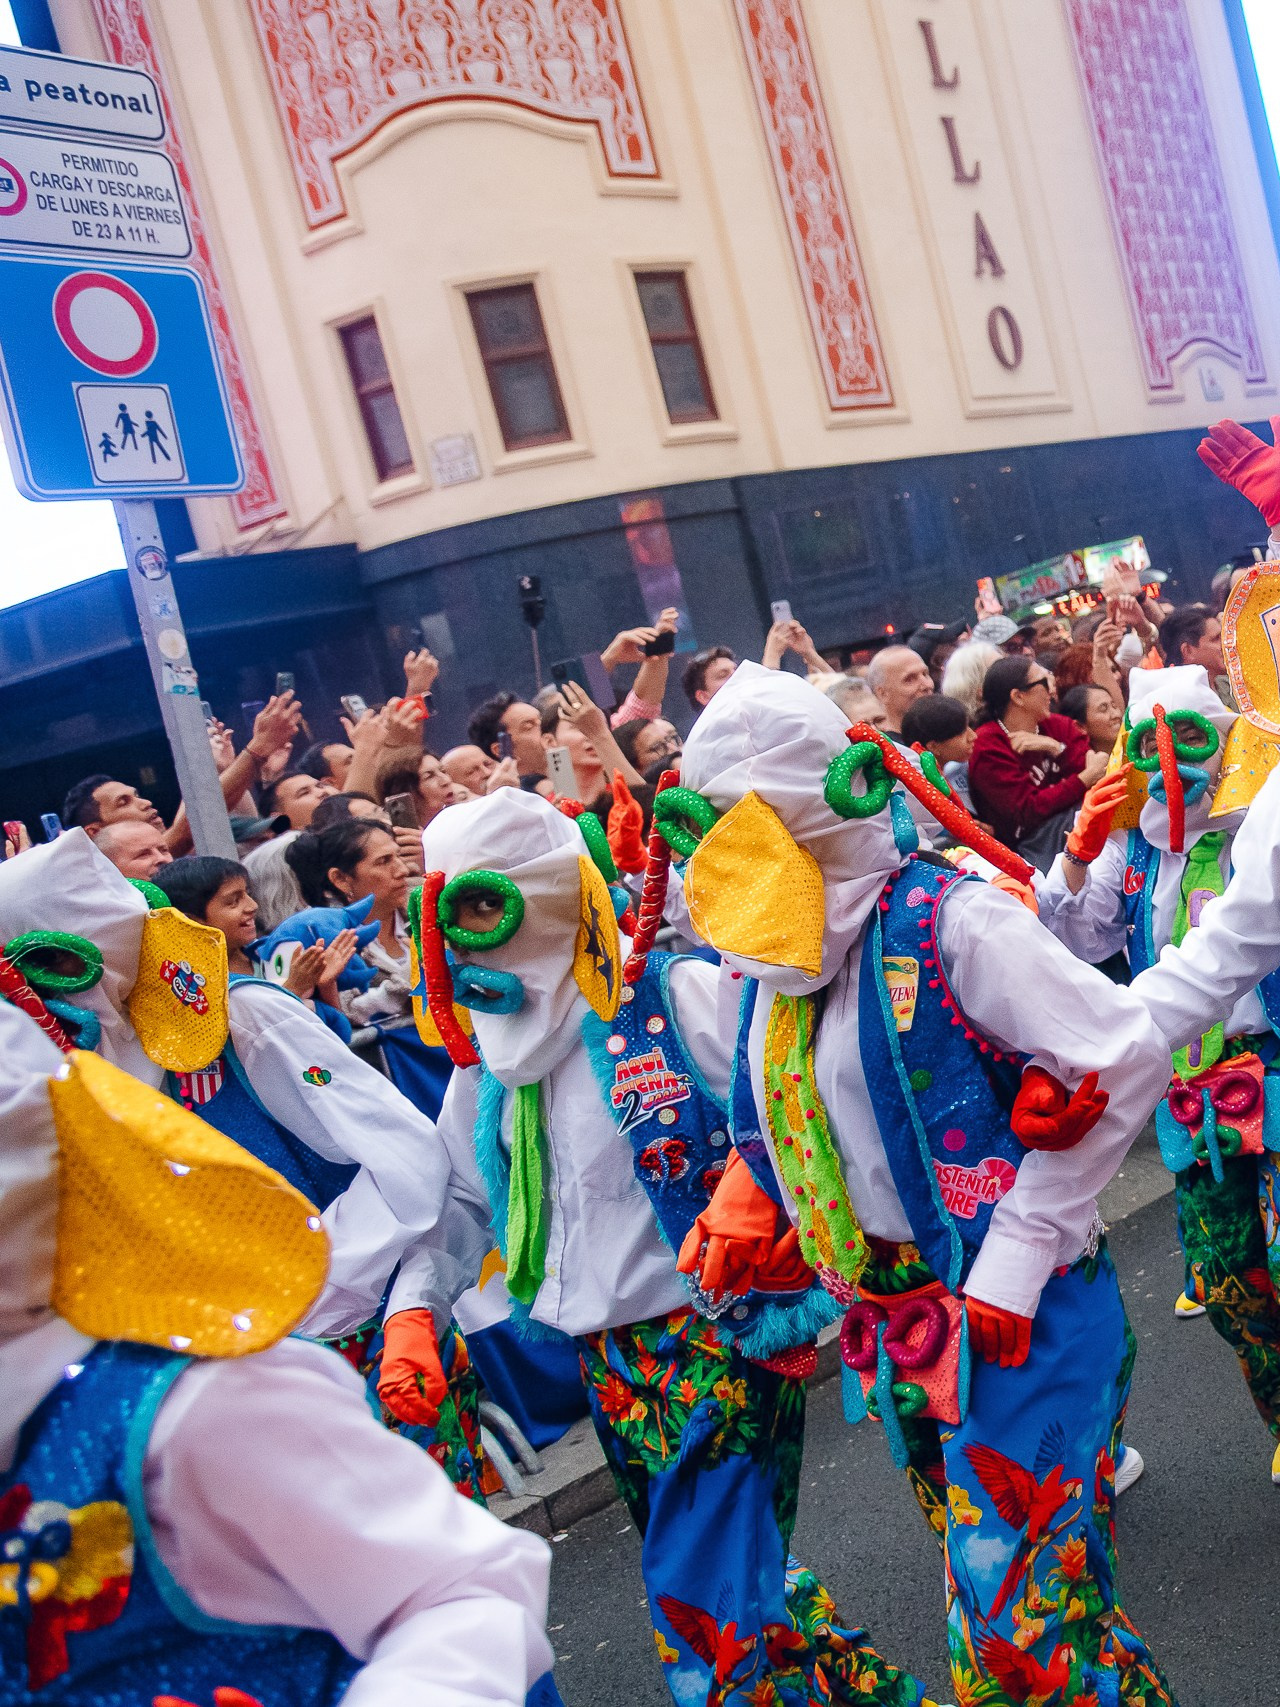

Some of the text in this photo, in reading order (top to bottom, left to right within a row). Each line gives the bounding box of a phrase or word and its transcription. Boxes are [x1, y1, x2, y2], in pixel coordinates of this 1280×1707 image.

[24, 79, 153, 115] peatonal
[61, 152, 139, 178] PERMITIDO
[30, 171, 83, 191] CARGA
[84, 178, 93, 194] Y
[98, 179, 175, 203] DESCARGA
[36, 194, 182, 225] DE LUNES A VIERNES
[72, 220, 92, 237] DE
[95, 223, 112, 239] 23
[116, 225, 126, 241] A
[129, 226, 142, 242] 11
[616, 1047, 666, 1082] AQUÍ
